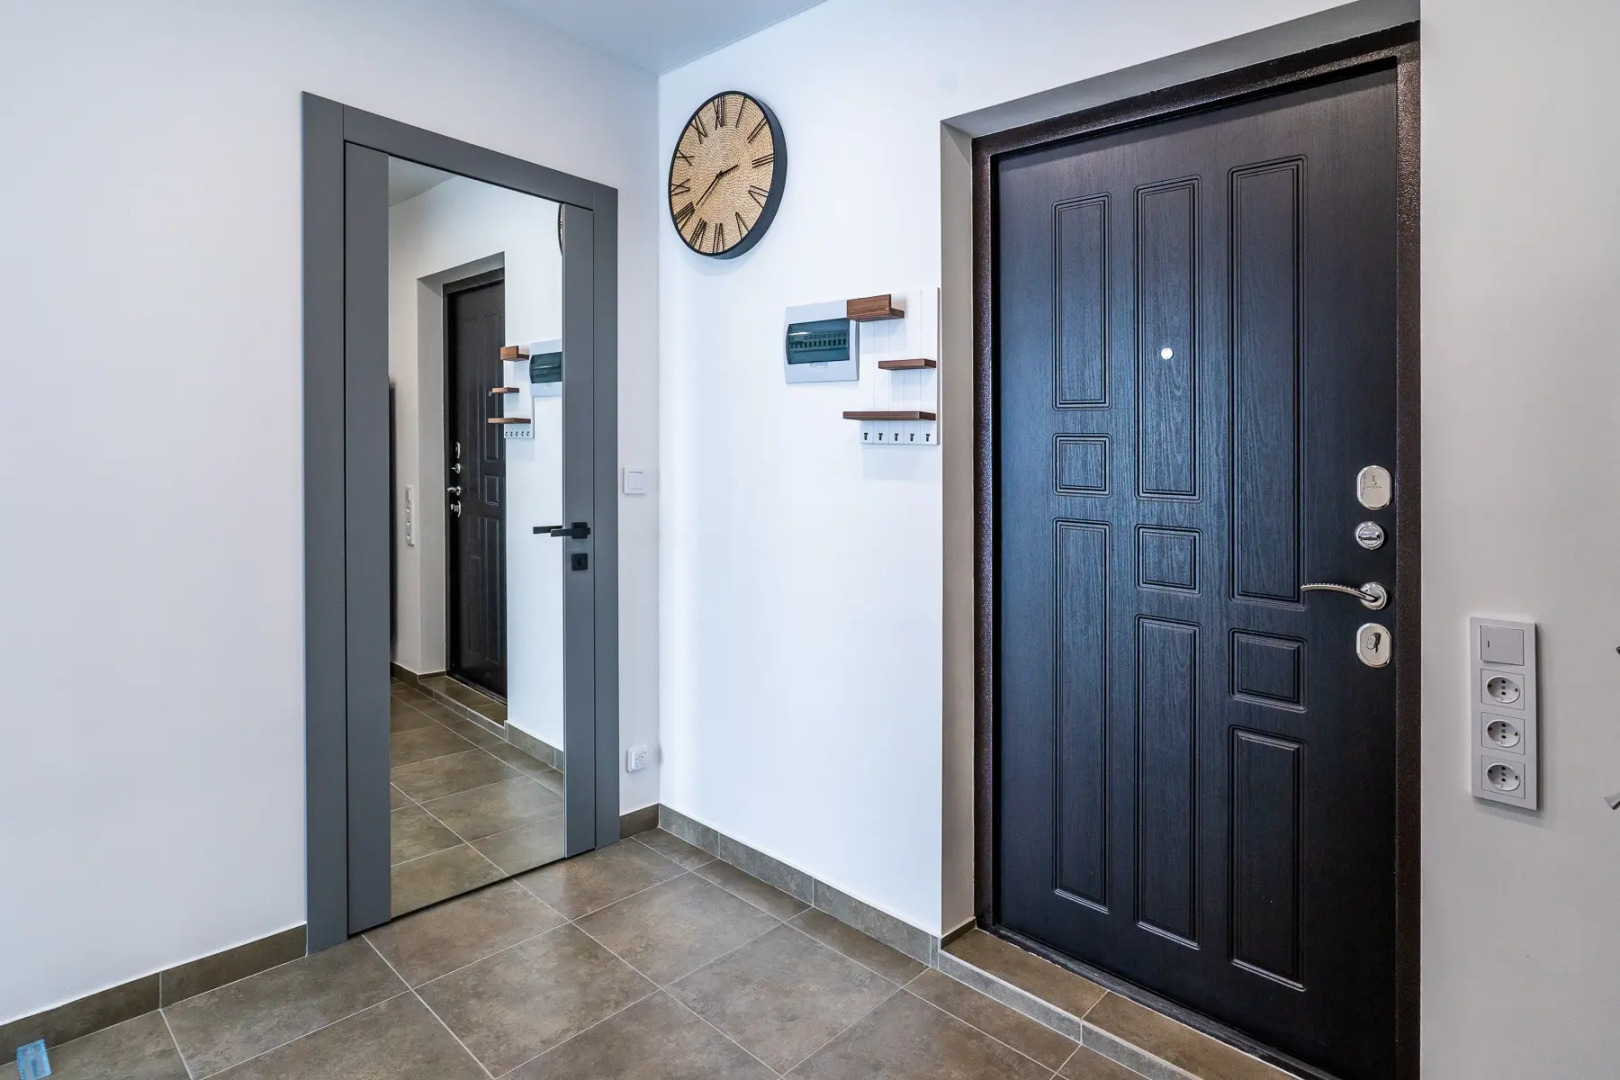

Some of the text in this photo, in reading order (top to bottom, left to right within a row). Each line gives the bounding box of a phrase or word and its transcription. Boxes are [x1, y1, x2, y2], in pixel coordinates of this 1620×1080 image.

[712, 96, 726, 131] XII
[735, 96, 747, 129] I
[689, 115, 708, 144] XI
[746, 117, 768, 144] II
[675, 149, 694, 166] X
[751, 153, 775, 169] III
[671, 178, 691, 196] IX
[748, 185, 770, 209] IV
[673, 201, 696, 232] VIII
[735, 212, 749, 241] V
[689, 218, 708, 251] VII
[712, 223, 725, 254] VI
